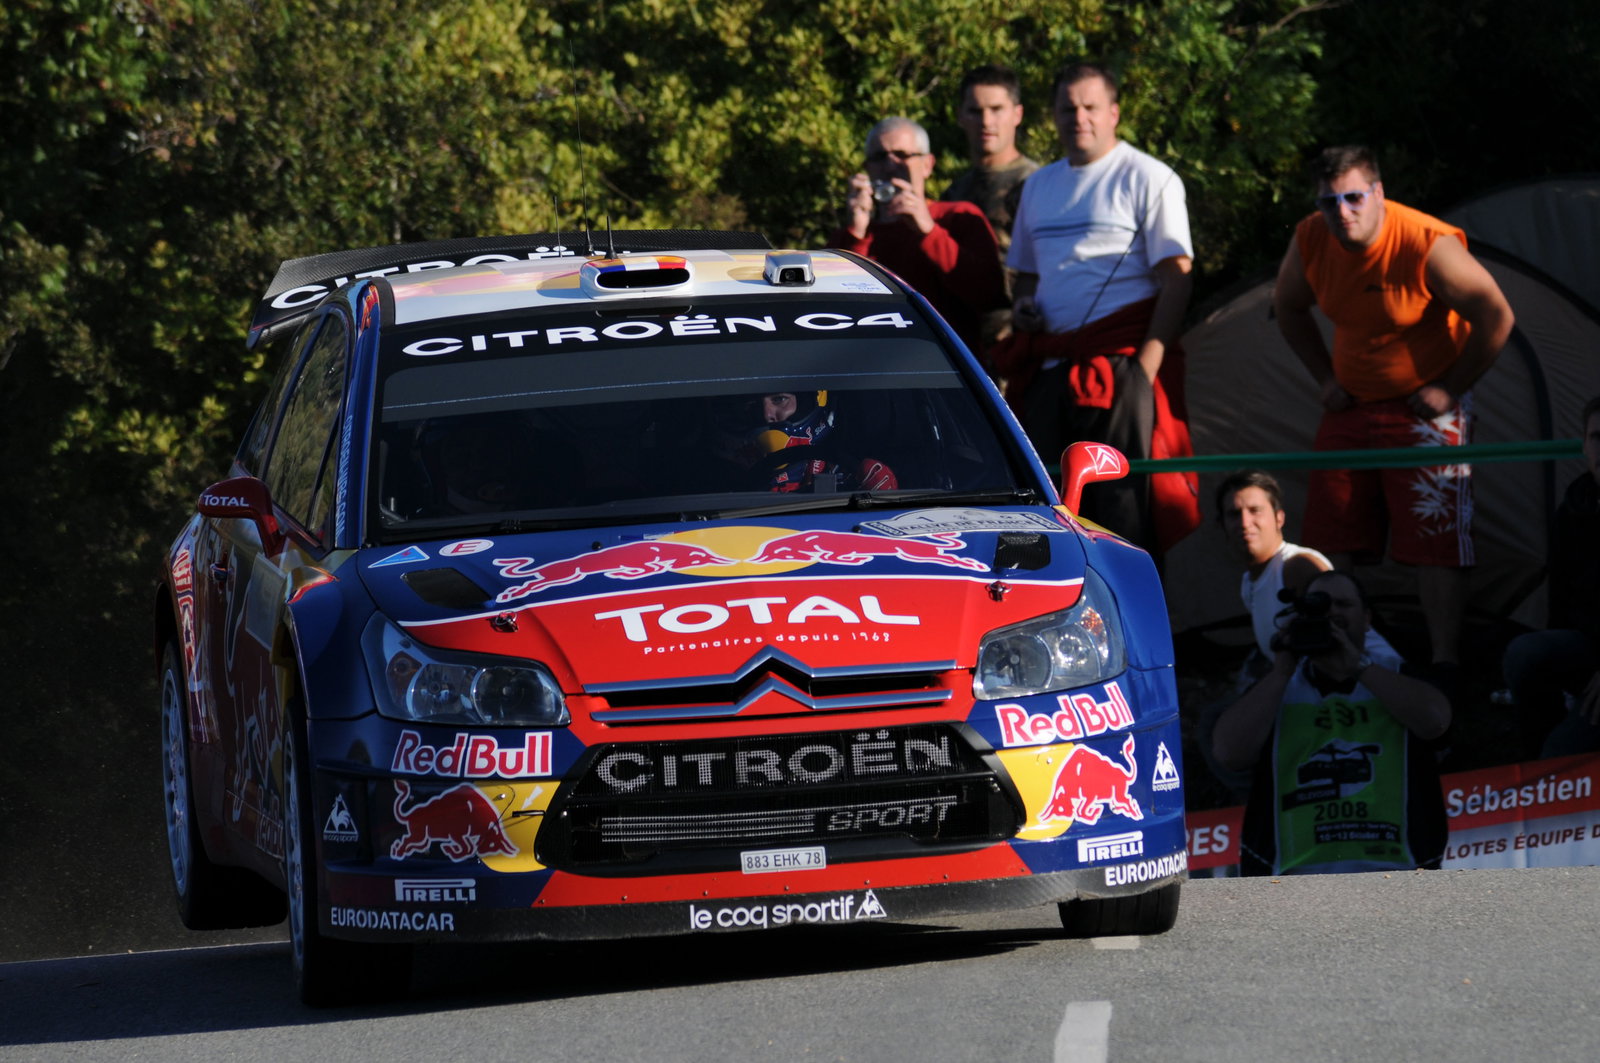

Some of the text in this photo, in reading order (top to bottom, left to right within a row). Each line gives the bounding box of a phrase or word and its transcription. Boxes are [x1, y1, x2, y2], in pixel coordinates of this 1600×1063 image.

[402, 312, 913, 357] CITROËN C4
[203, 494, 249, 508] TOTAL
[450, 541, 482, 554] E
[595, 595, 920, 642] TOTAL
[644, 635, 763, 654] Partenaires
[776, 633, 839, 643] depuis
[995, 681, 1135, 747] Red Bull
[392, 730, 552, 778] Red Bull
[597, 729, 951, 791] CITROËN
[1313, 801, 1368, 821] 2008
[1445, 774, 1592, 818] Sébastien
[827, 800, 957, 832] SPORT
[1077, 830, 1144, 863] PIRELLI
[1514, 826, 1586, 850] ÉQUIPE
[746, 851, 822, 870] 883 EHK 78
[1104, 850, 1188, 887] EURODATACAR
[394, 879, 476, 902] PIRELLI
[330, 906, 455, 932] EURODATACAR
[689, 894, 854, 929] le coq sportif
